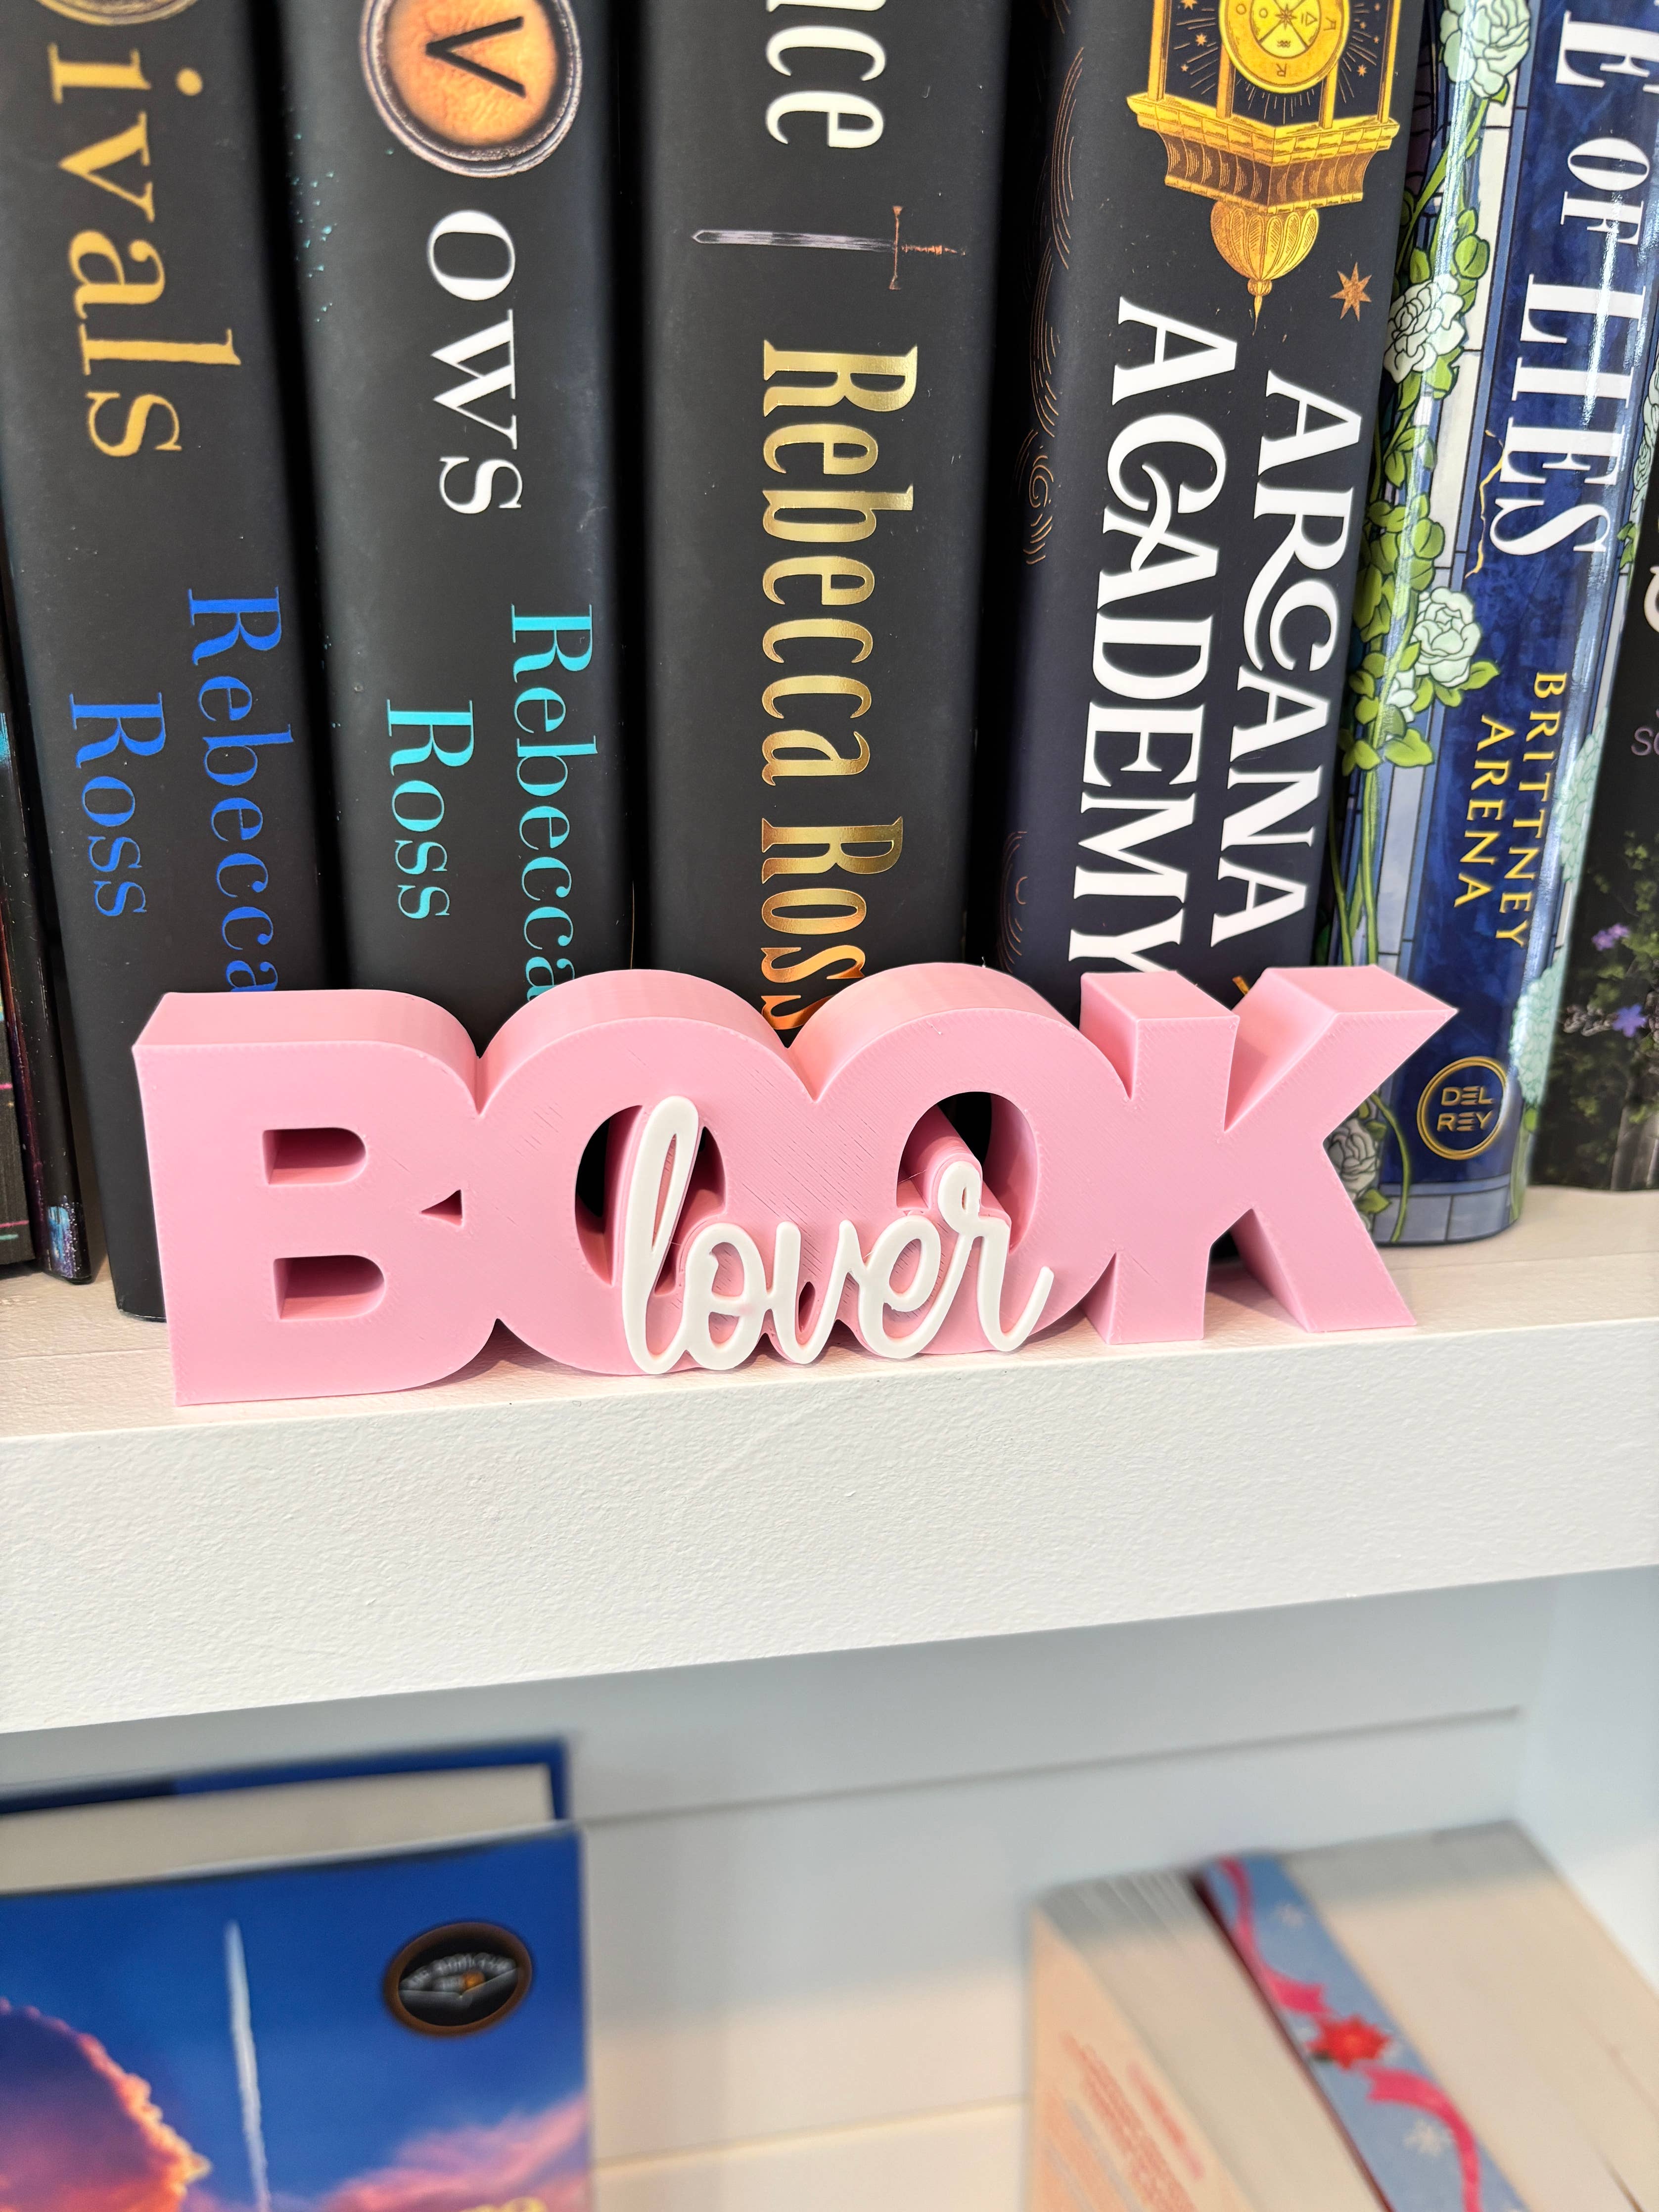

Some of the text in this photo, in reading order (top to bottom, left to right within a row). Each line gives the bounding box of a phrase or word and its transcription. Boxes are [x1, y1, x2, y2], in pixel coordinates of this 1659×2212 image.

[47, 42, 241, 458] ivals
[1560, 137, 1650, 245] OF
[1490, 274, 1646, 555] LIES
[761, 339, 918, 786] Rebecca
[1068, 297, 1238, 972] ACADEMY
[1210, 369, 1362, 947] ARCANA
[69, 692, 166, 917] Ross
[387, 699, 475, 920] Ross
[1454, 714, 1516, 908] ARENA
[1496, 671, 1568, 948] BRITTNEY
[132, 967, 1457, 1405] BOOK
[1436, 1109, 1493, 1132] REY
[1440, 1085, 1496, 1106] DEL
[622, 1095, 1055, 1376] lover
